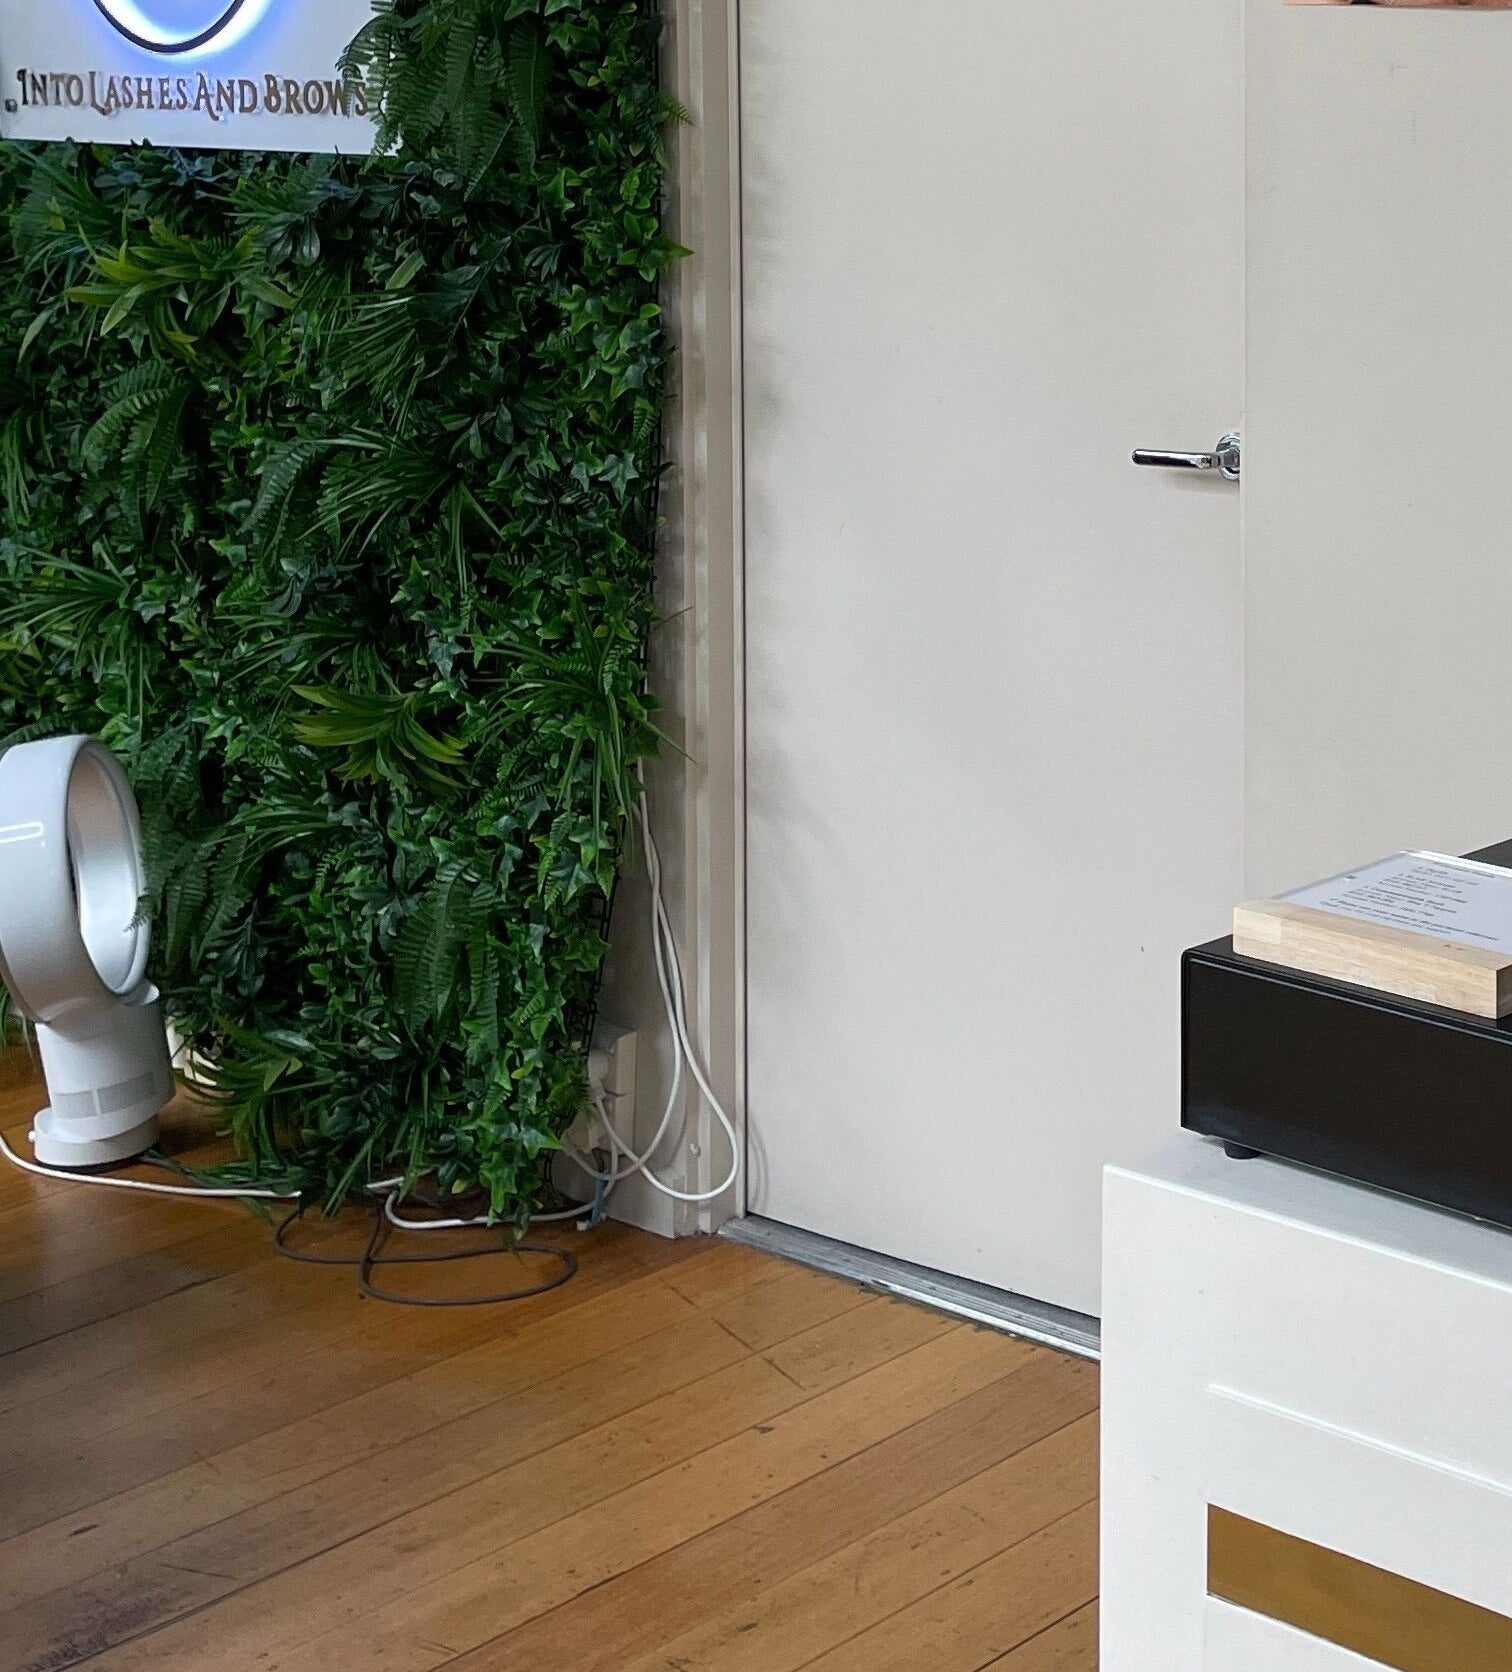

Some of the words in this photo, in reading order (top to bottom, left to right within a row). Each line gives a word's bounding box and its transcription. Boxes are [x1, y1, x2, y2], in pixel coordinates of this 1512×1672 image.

[17, 69, 84, 106] INTO
[89, 71, 188, 116] LASHES
[192, 72, 258, 121] AND
[264, 74, 368, 117] BROWS
